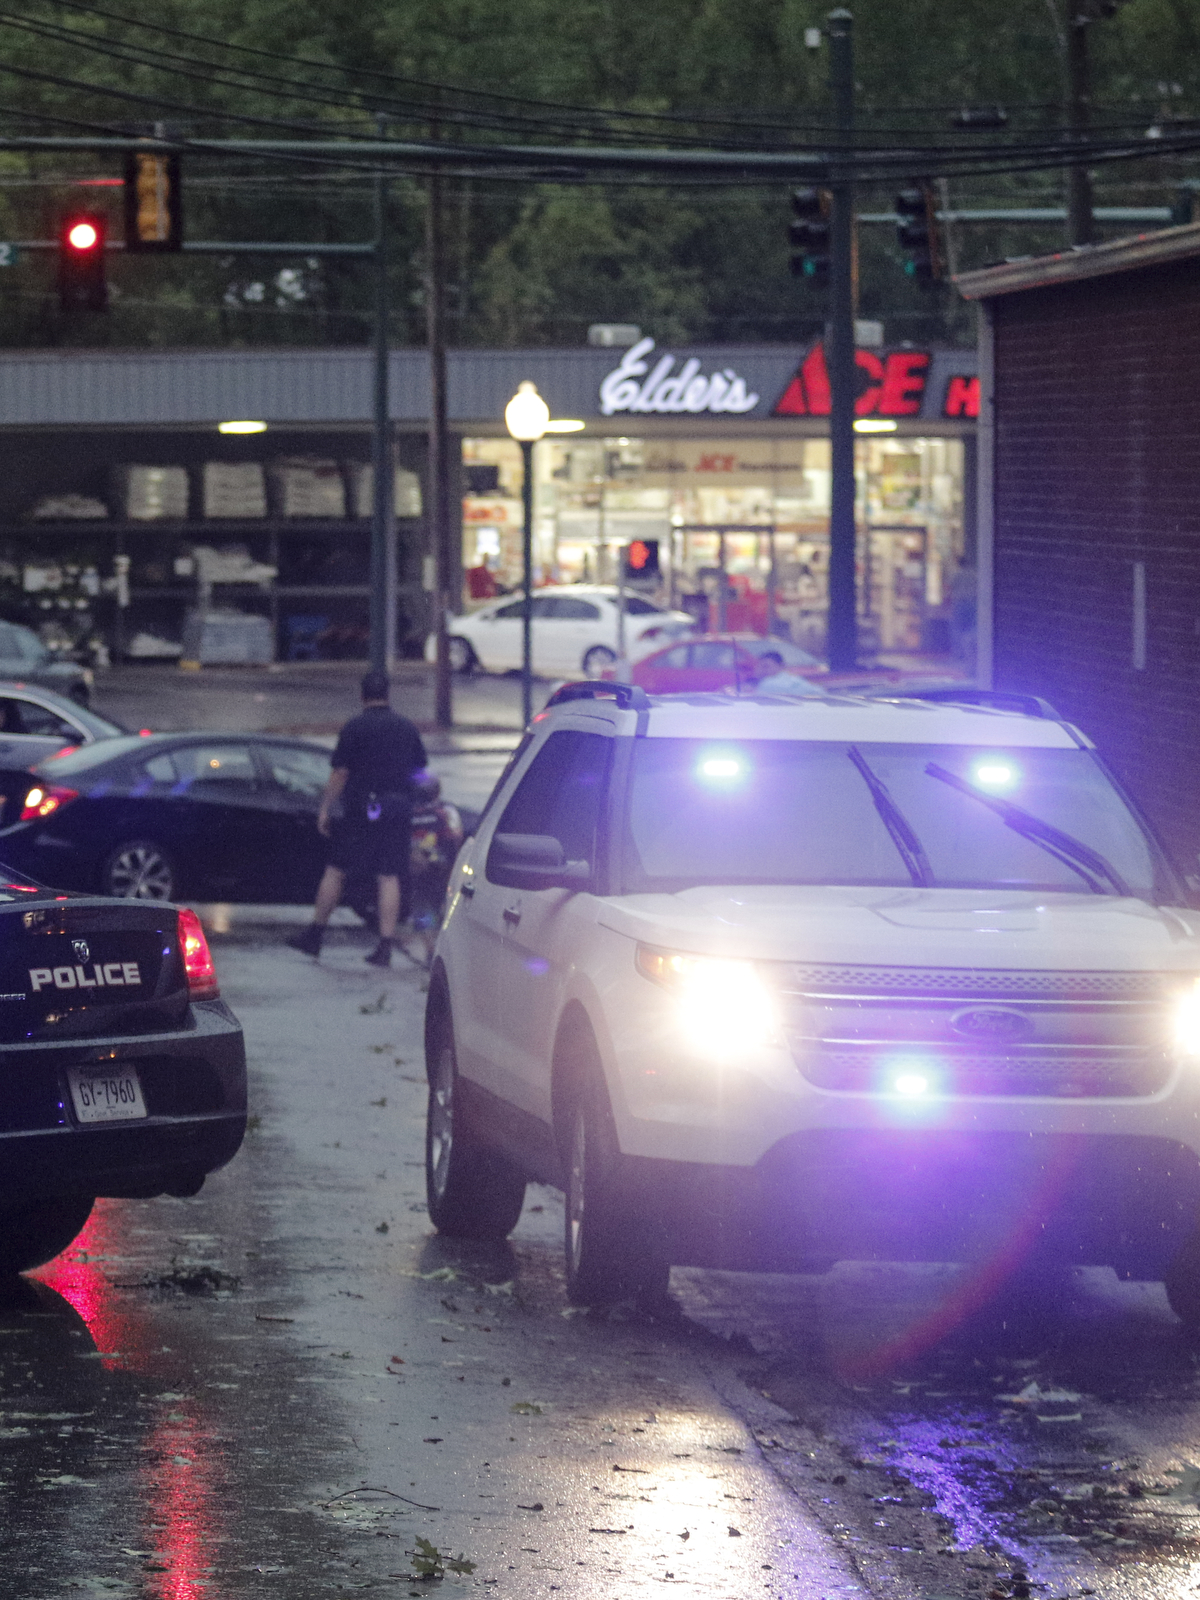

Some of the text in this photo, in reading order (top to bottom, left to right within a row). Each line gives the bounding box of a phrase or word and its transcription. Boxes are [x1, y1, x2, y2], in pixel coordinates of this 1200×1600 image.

[601, 336, 760, 416] Elder's
[774, 343, 929, 416] ACE
[29, 962, 142, 992] POLICE
[79, 1079, 136, 1106] GY-7960
